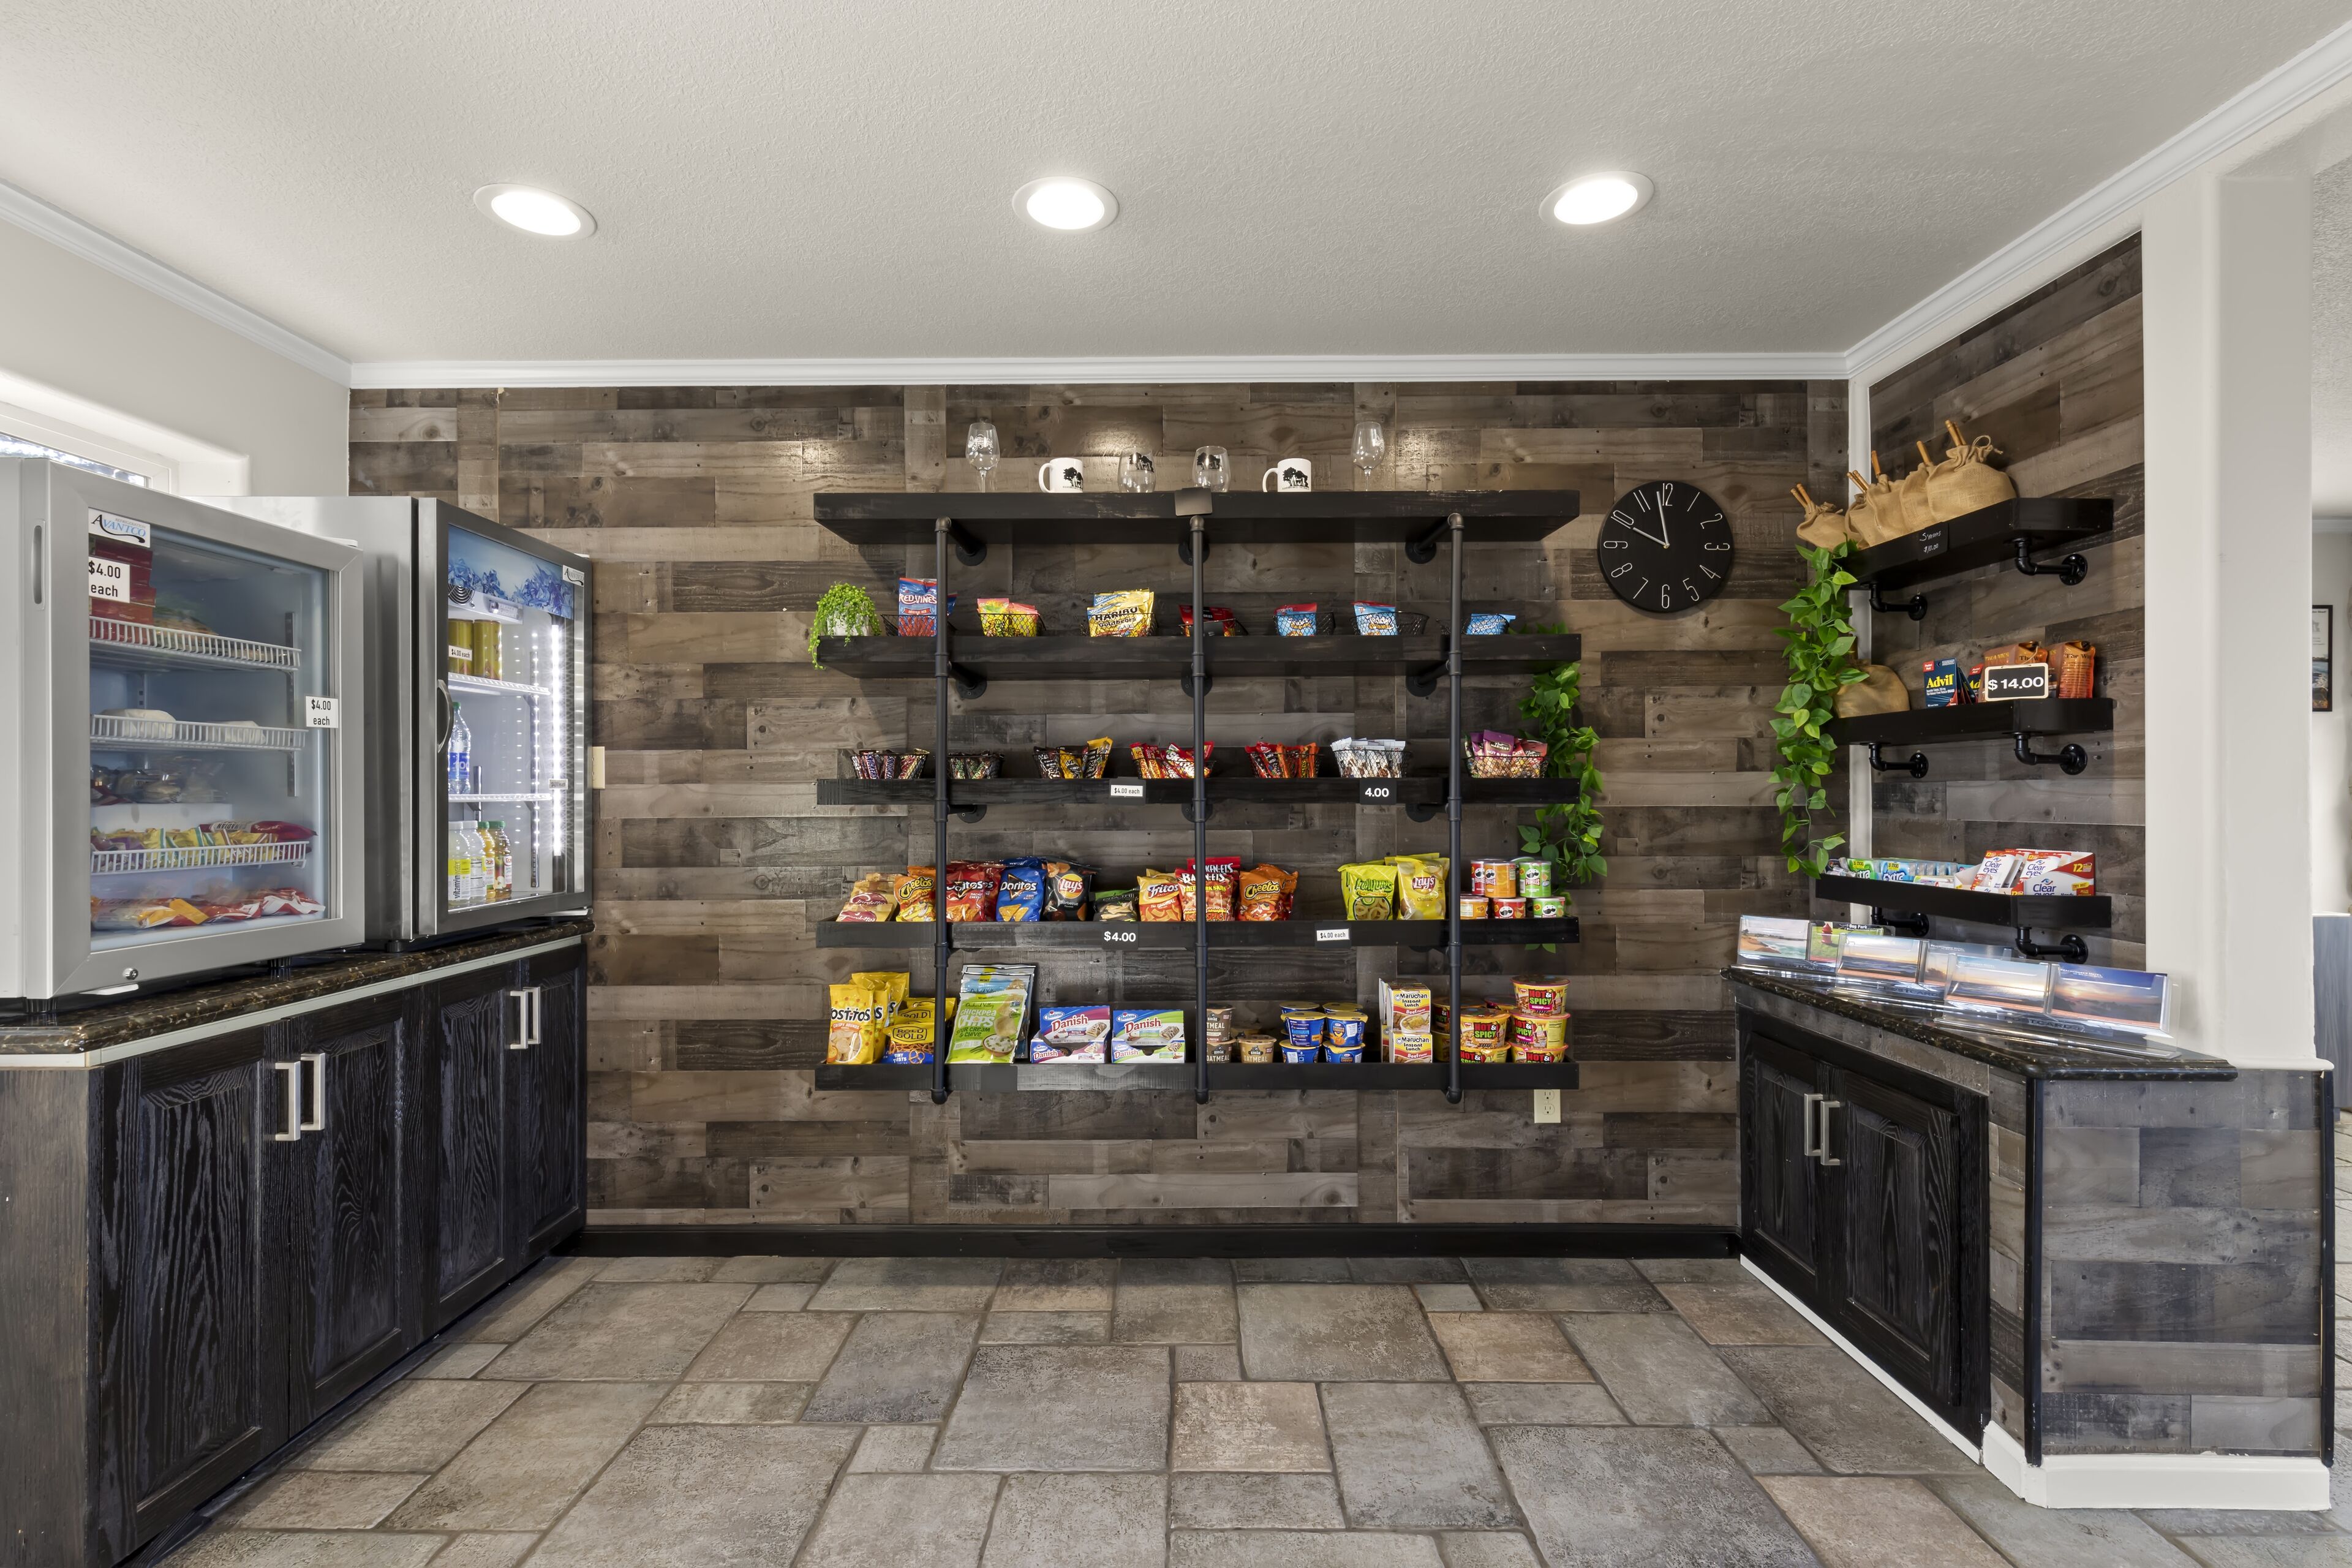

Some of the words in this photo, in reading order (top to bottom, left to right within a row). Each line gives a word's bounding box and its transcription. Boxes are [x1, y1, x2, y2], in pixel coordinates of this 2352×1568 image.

[1633, 490, 1651, 512] 11
[1662, 483, 1673, 506] 12
[1687, 492, 1700, 512] 1
[1610, 510, 1634, 529] 10
[1700, 513, 1723, 529] 2
[91, 514, 146, 543] AVANTCO
[1603, 540, 1628, 549] 9
[88, 560, 121, 579] $4.00
[1611, 562, 1633, 578] 8
[1699, 565, 1722, 579] 4
[91, 584, 118, 597] each
[1632, 577, 1649, 599] 7
[1683, 577, 1700, 601] 5
[899, 594, 916, 605] RED
[915, 594, 937, 605] VINES
[1661, 584, 1670, 609] 6
[1095, 606, 1138, 621] HARIBO
[1098, 617, 1137, 627] Goldbears
[1926, 674, 1953, 688] Advil
[1988, 679, 1998, 690] $
[2000, 676, 2045, 689] 14.00
[311, 698, 331, 710] $4.00
[313, 716, 330, 725] each
[1365, 788, 1389, 797] 4.00
[1856, 870, 1871, 878] xtra
[1983, 867, 1999, 875] eyes
[2073, 863, 2083, 872] 12
[900, 876, 933, 899] Cheetos
[1000, 882, 1037, 891] Doritos
[1059, 878, 1083, 893] Lay's
[1245, 881, 1280, 899] Cheetos
[1414, 876, 1436, 891] Lay's
[2033, 884, 2057, 892] Clear
[1147, 884, 1178, 899] Fritos
[1104, 930, 1136, 942] $4.00
[1052, 1015, 1088, 1031] Danish
[1125, 1017, 1161, 1033] Danish
[1514, 1019, 1526, 1027] HOT
[1515, 1027, 1532, 1036] SPICY
[1034, 1050, 1058, 1060] Danish
[1115, 1049, 1139, 1059] Danish
[1460, 1050, 1476, 1060] HOT
[1526, 1052, 1544, 1061] HOT
